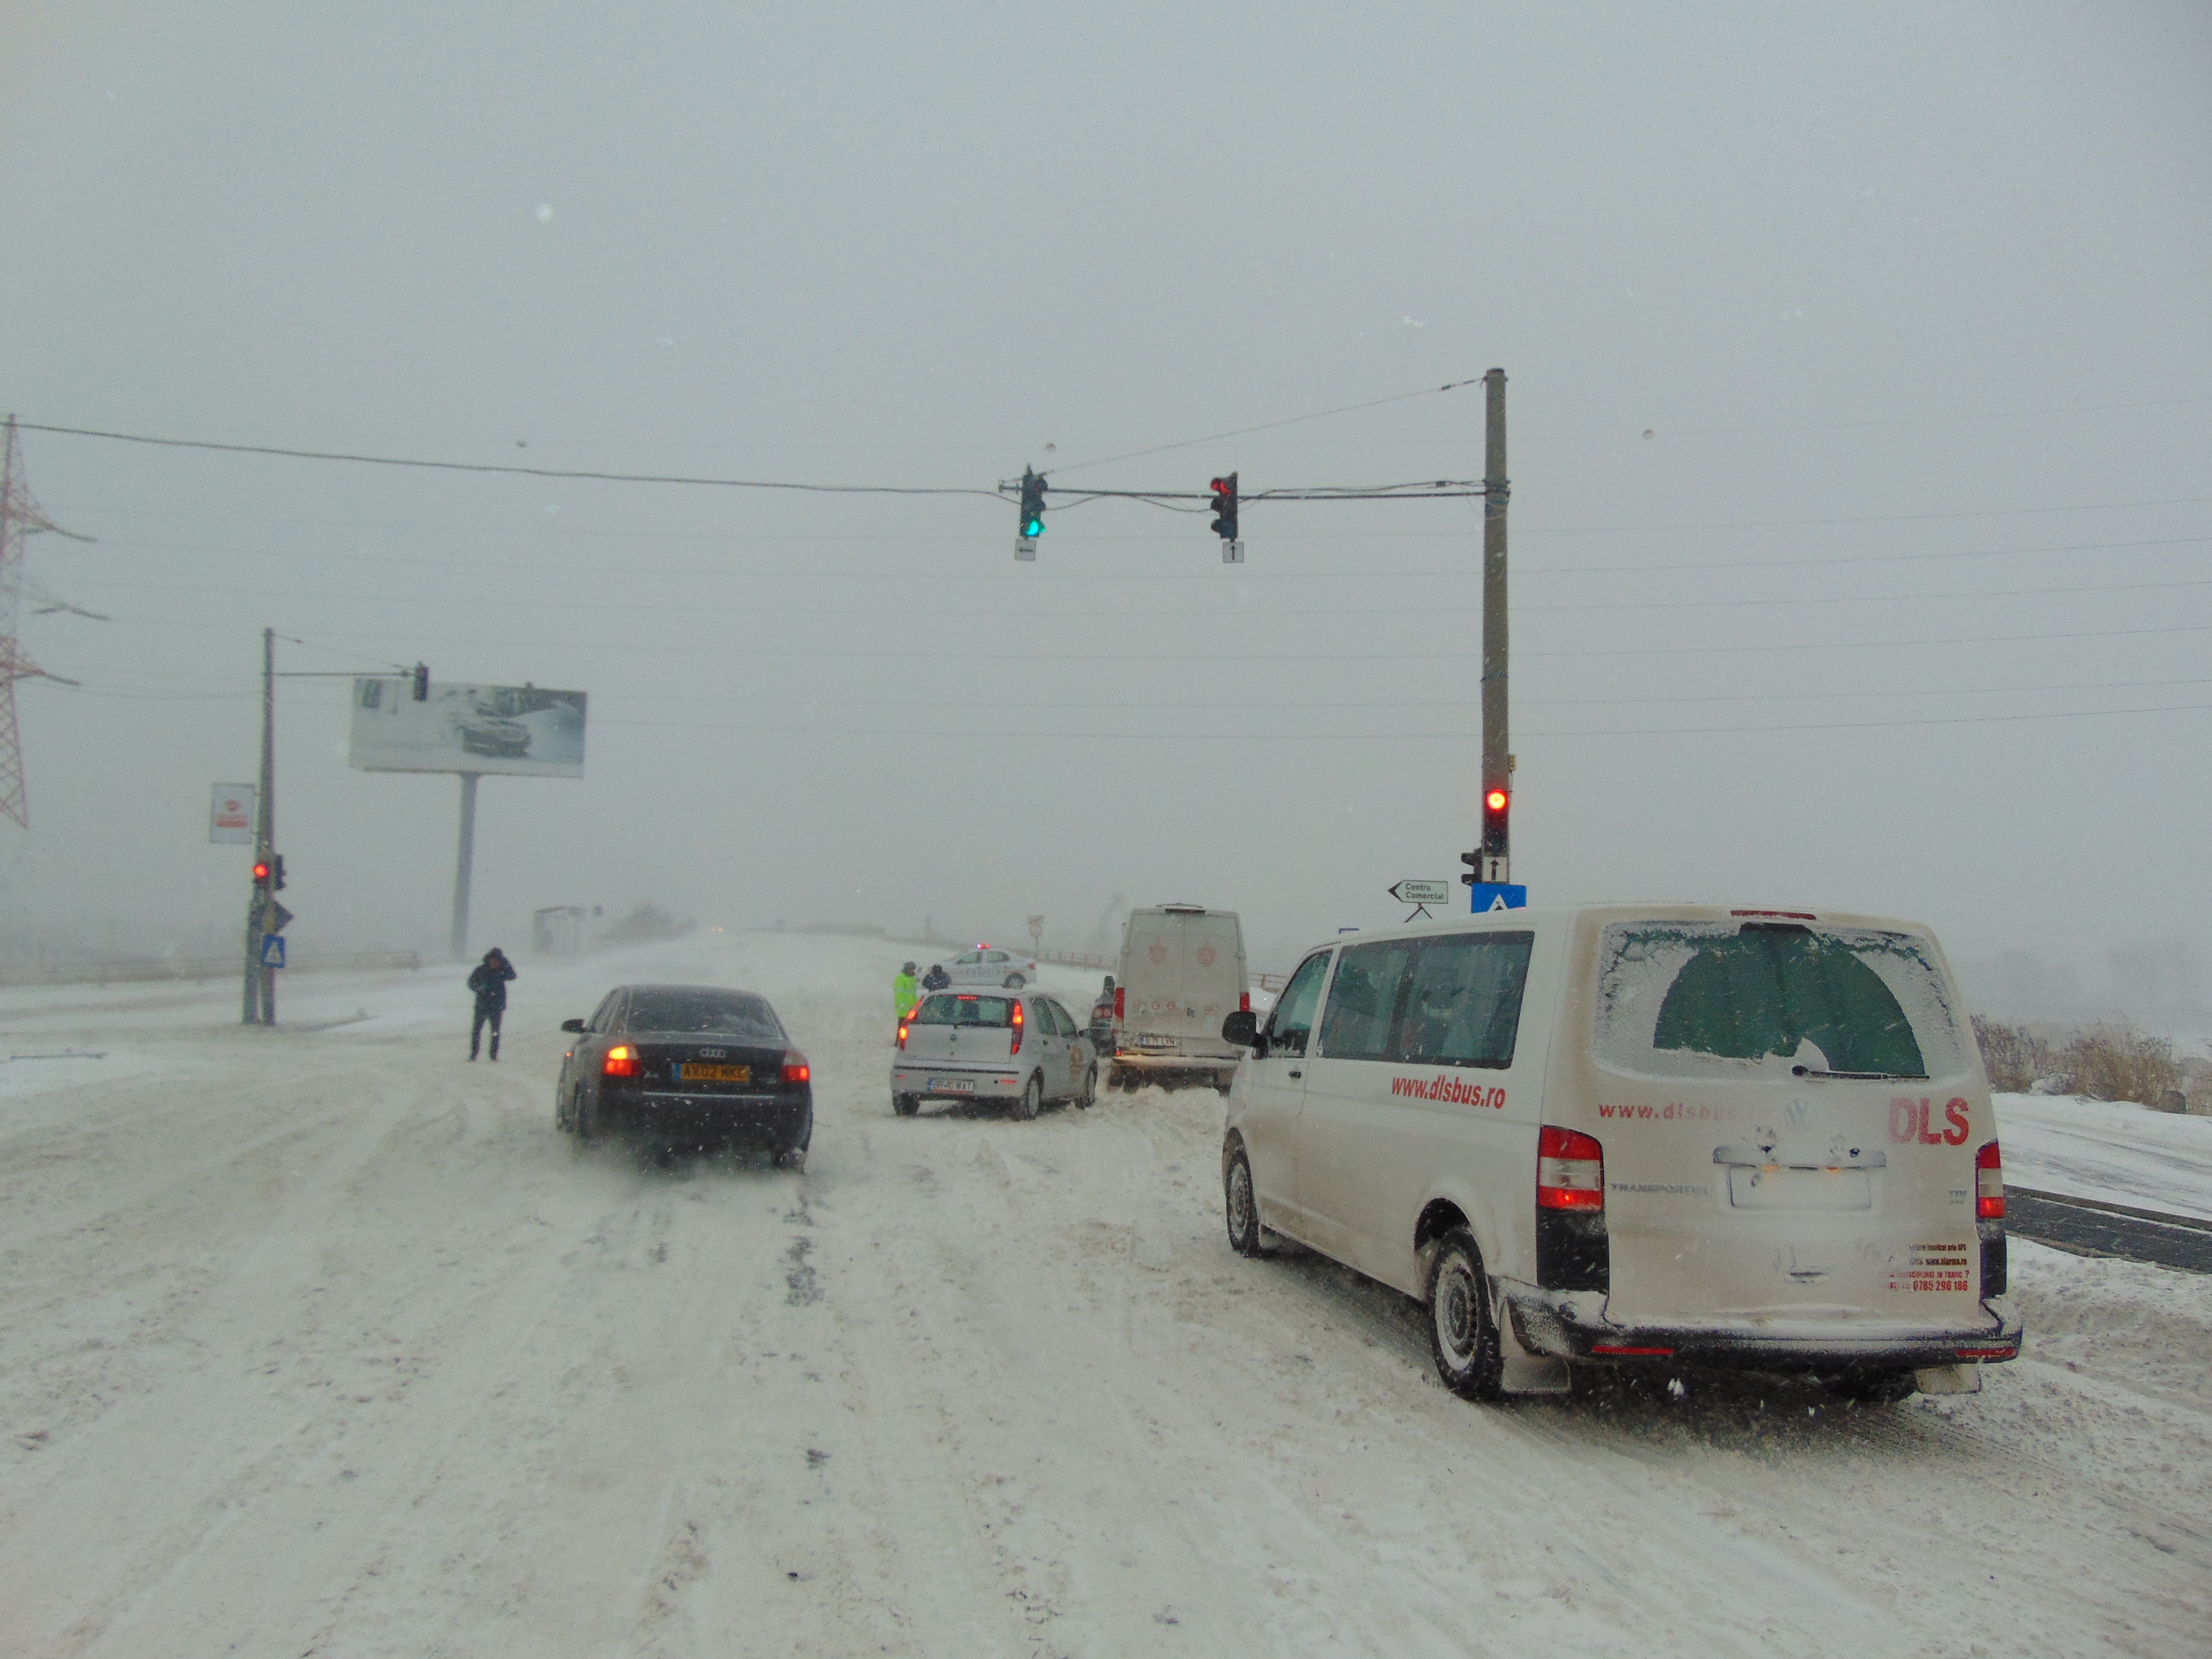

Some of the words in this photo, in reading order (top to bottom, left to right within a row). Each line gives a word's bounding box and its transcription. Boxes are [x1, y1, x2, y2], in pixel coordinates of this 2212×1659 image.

[1406, 883, 1431, 891] Centru
[1406, 891, 1444, 899] Comercial
[1392, 1075, 1506, 1109] www.dlsbus.ro
[1887, 1097, 1970, 1146] DLS
[1936, 1280, 1951, 1291] 296
